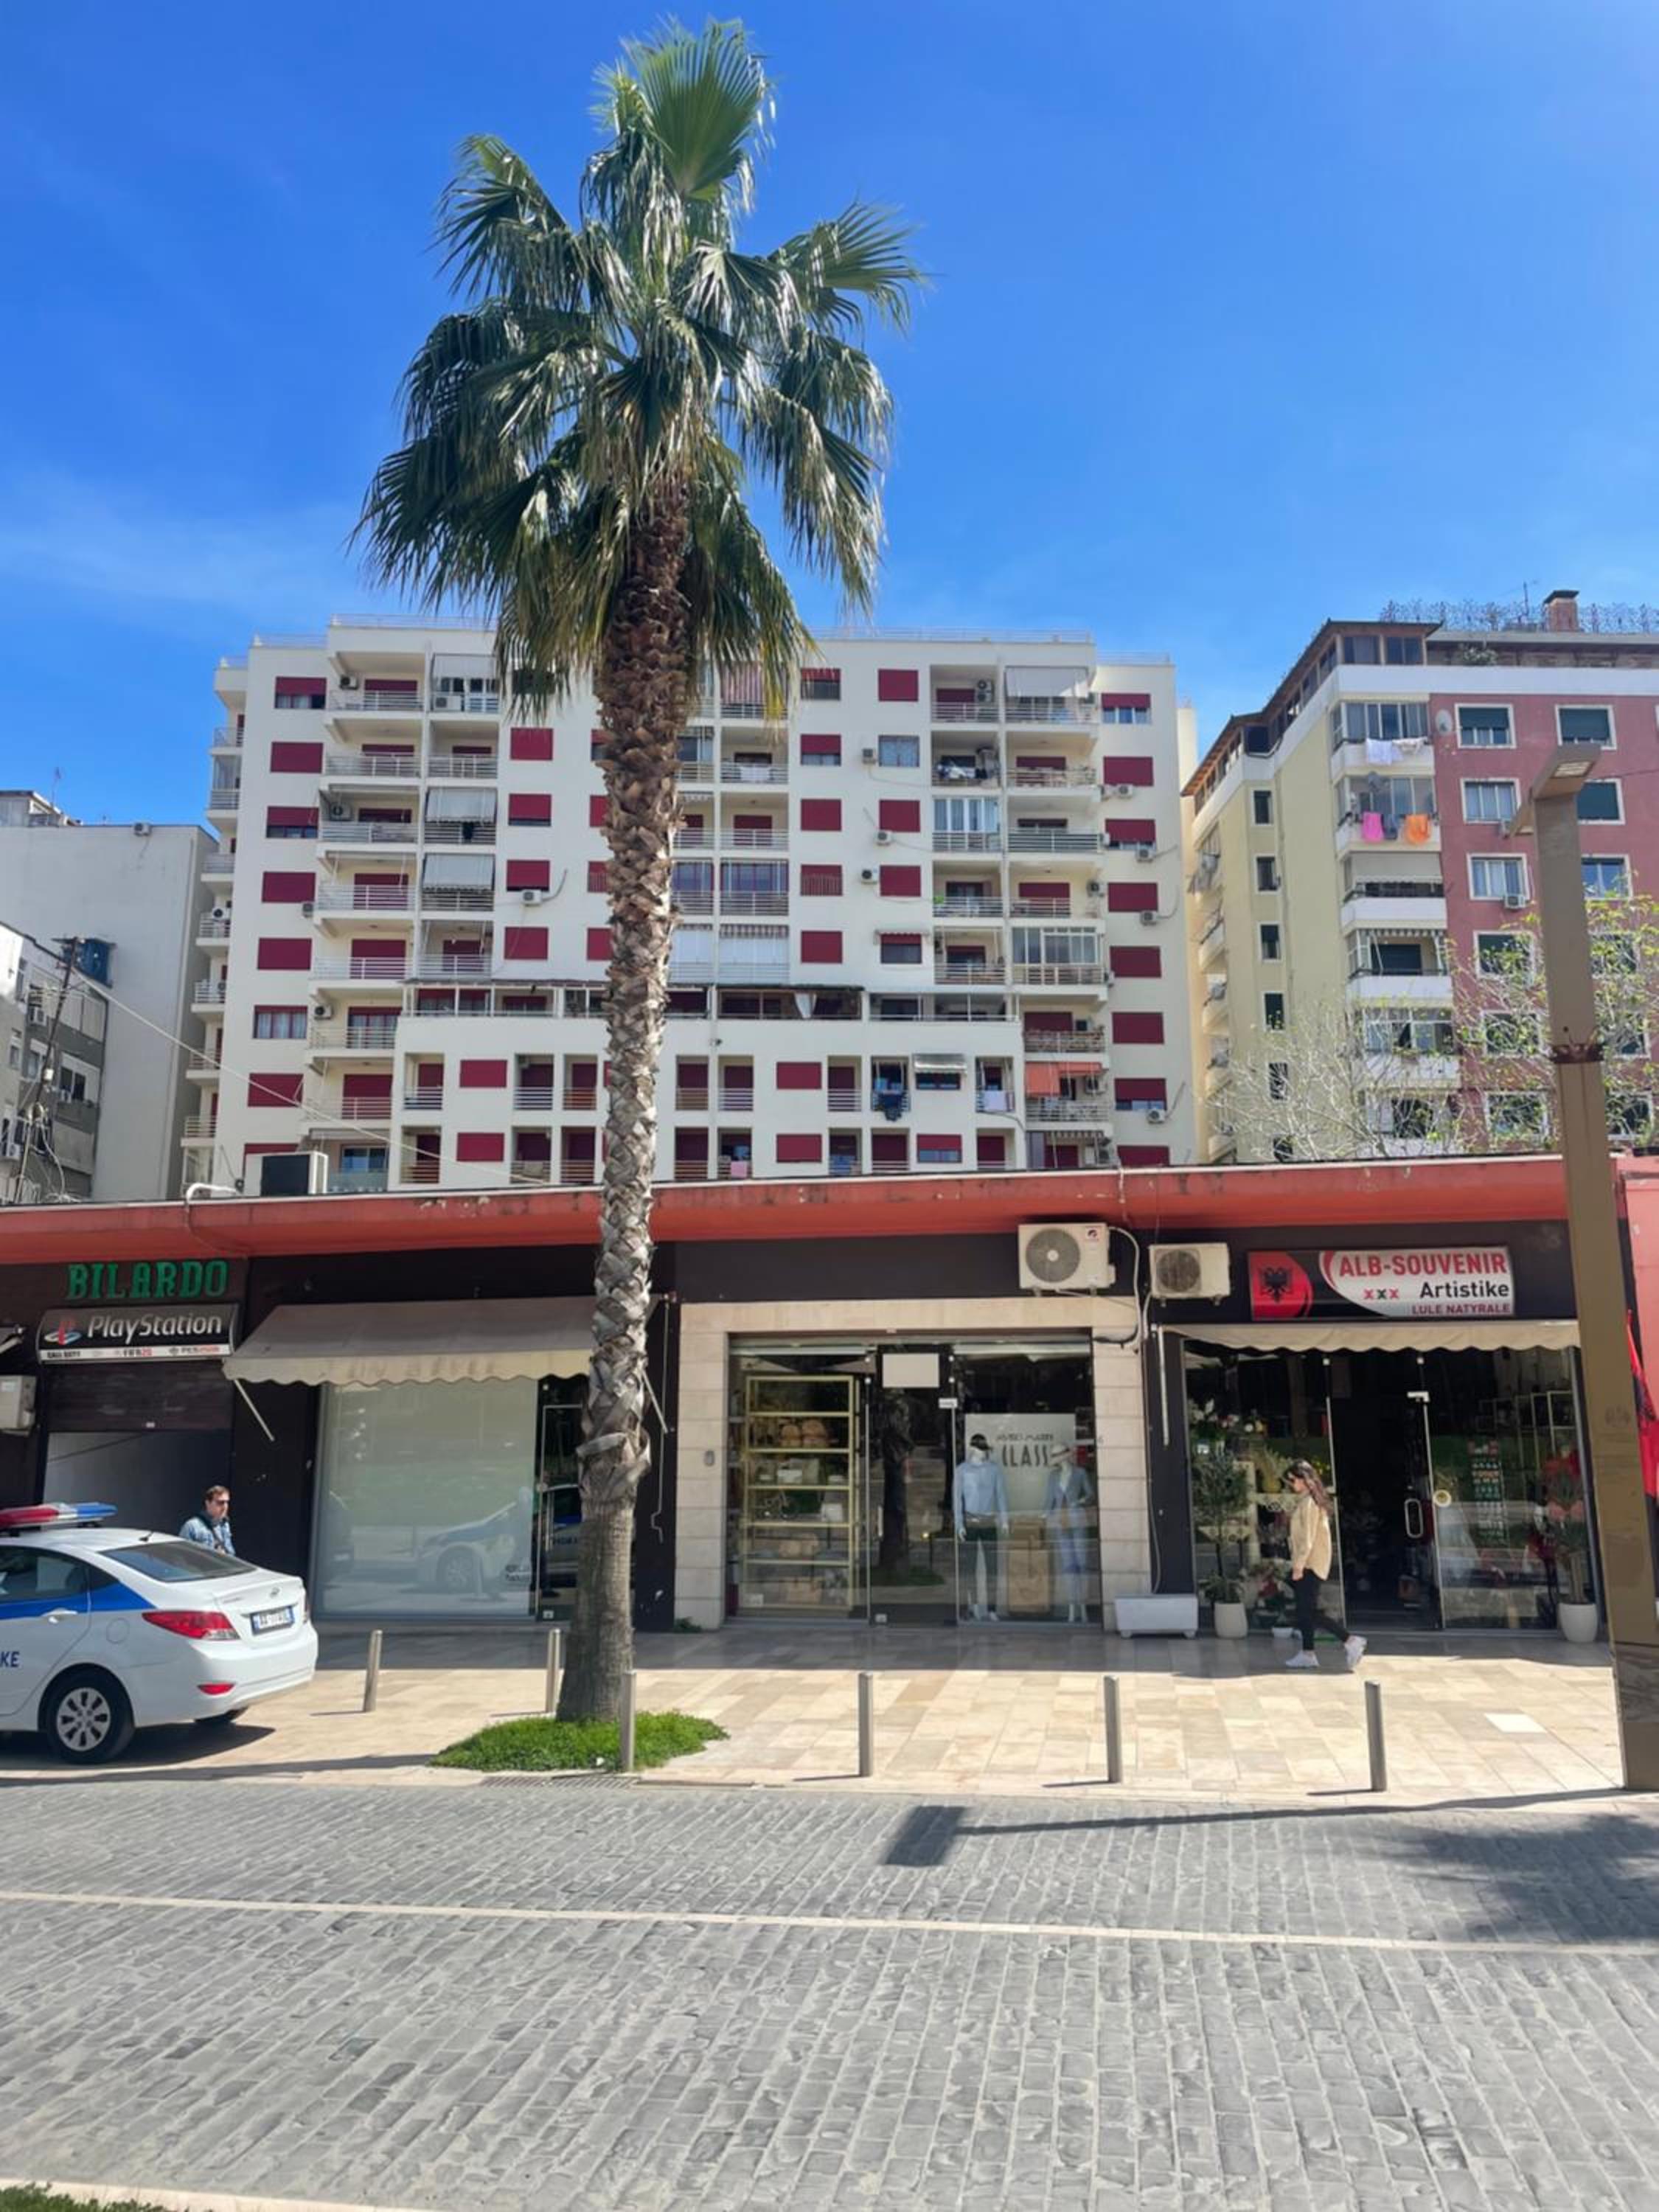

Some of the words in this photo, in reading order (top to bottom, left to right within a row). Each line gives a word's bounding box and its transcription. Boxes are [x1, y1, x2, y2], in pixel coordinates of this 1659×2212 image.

[1339, 1253, 1507, 1277] ALB-SOUVENIR
[67, 1260, 229, 1299] BILARDO
[1419, 1279, 1509, 1299] Artistike
[1411, 1304, 1443, 1315] LULE
[1446, 1302, 1511, 1314] NATYRALE
[87, 1312, 222, 1344] PlayStation
